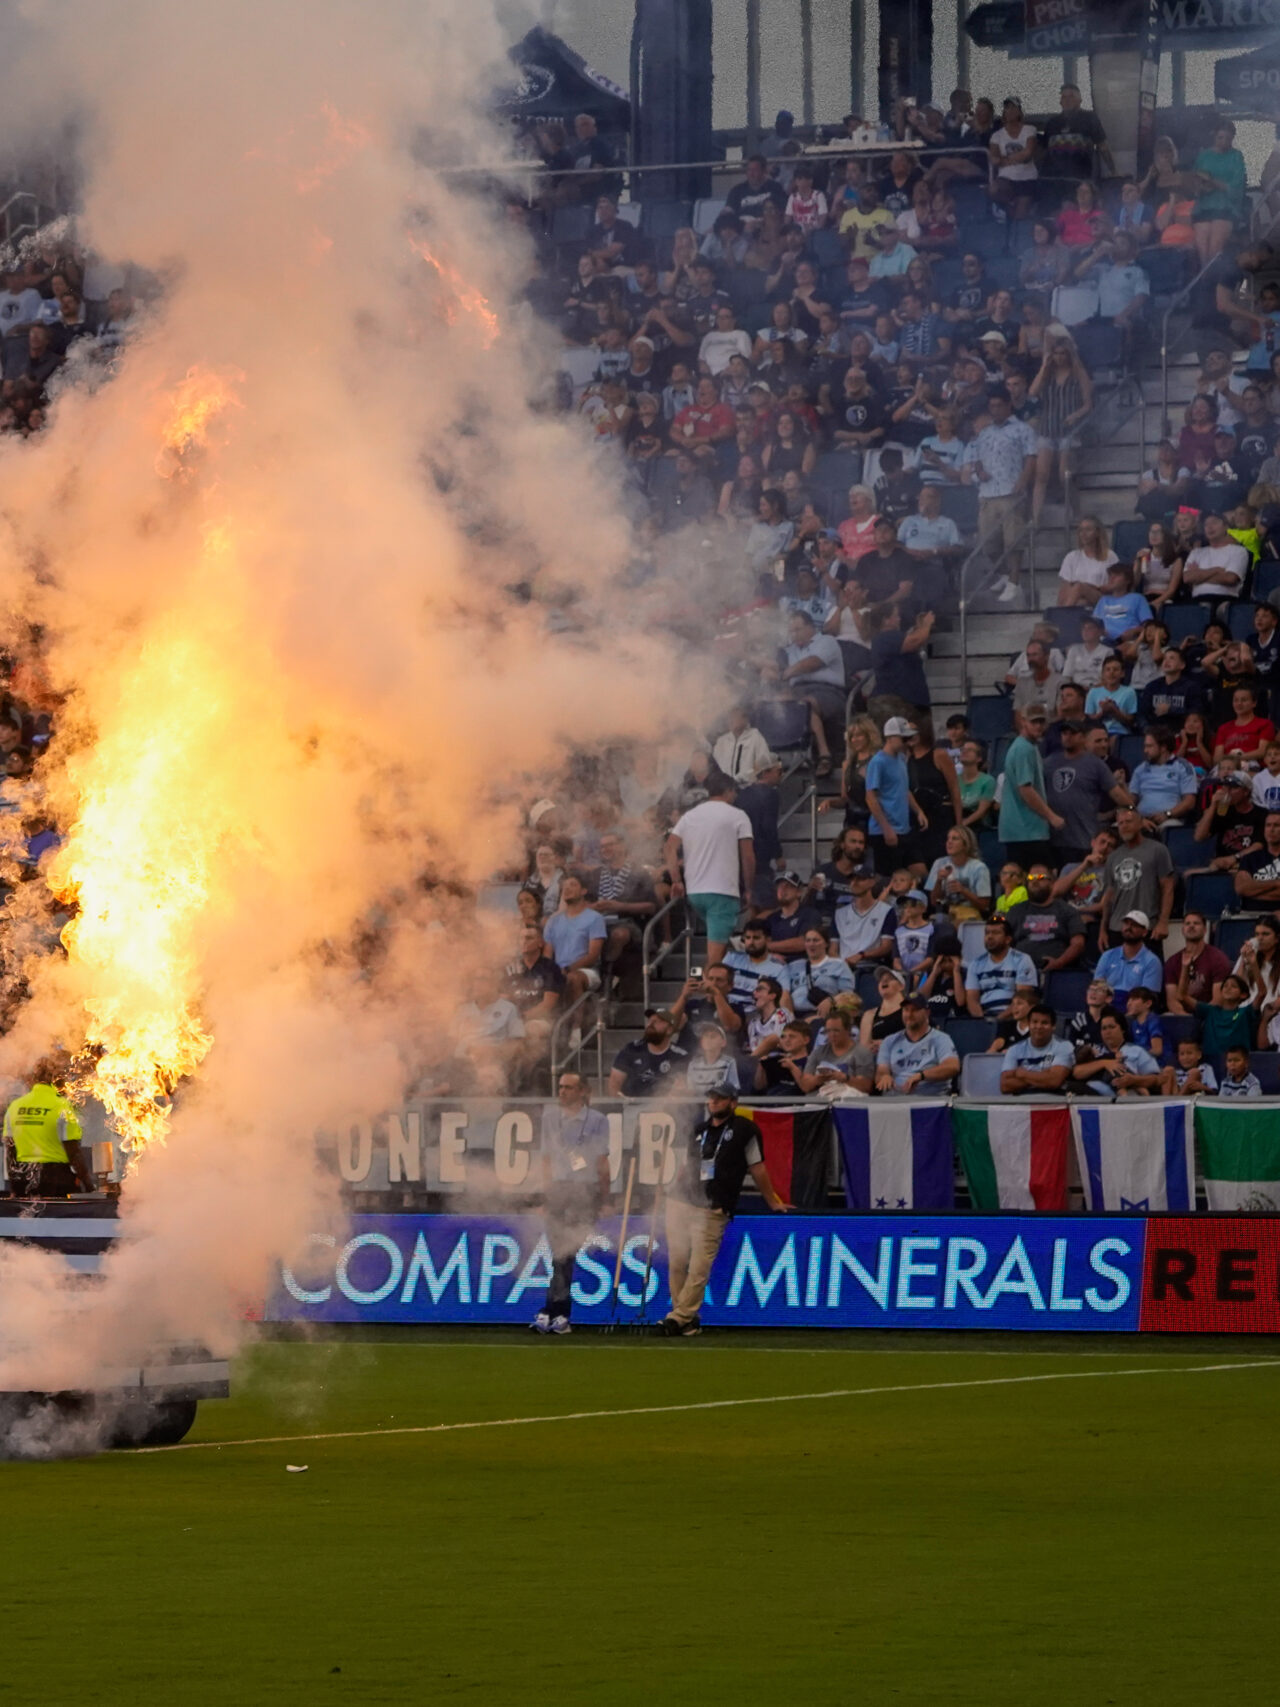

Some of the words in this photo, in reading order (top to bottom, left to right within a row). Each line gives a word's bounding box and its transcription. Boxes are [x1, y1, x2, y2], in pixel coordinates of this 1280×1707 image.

[17, 1107, 51, 1116] BEST
[337, 1111, 469, 1183] ONE
[726, 1233, 1131, 1312] MINERALS
